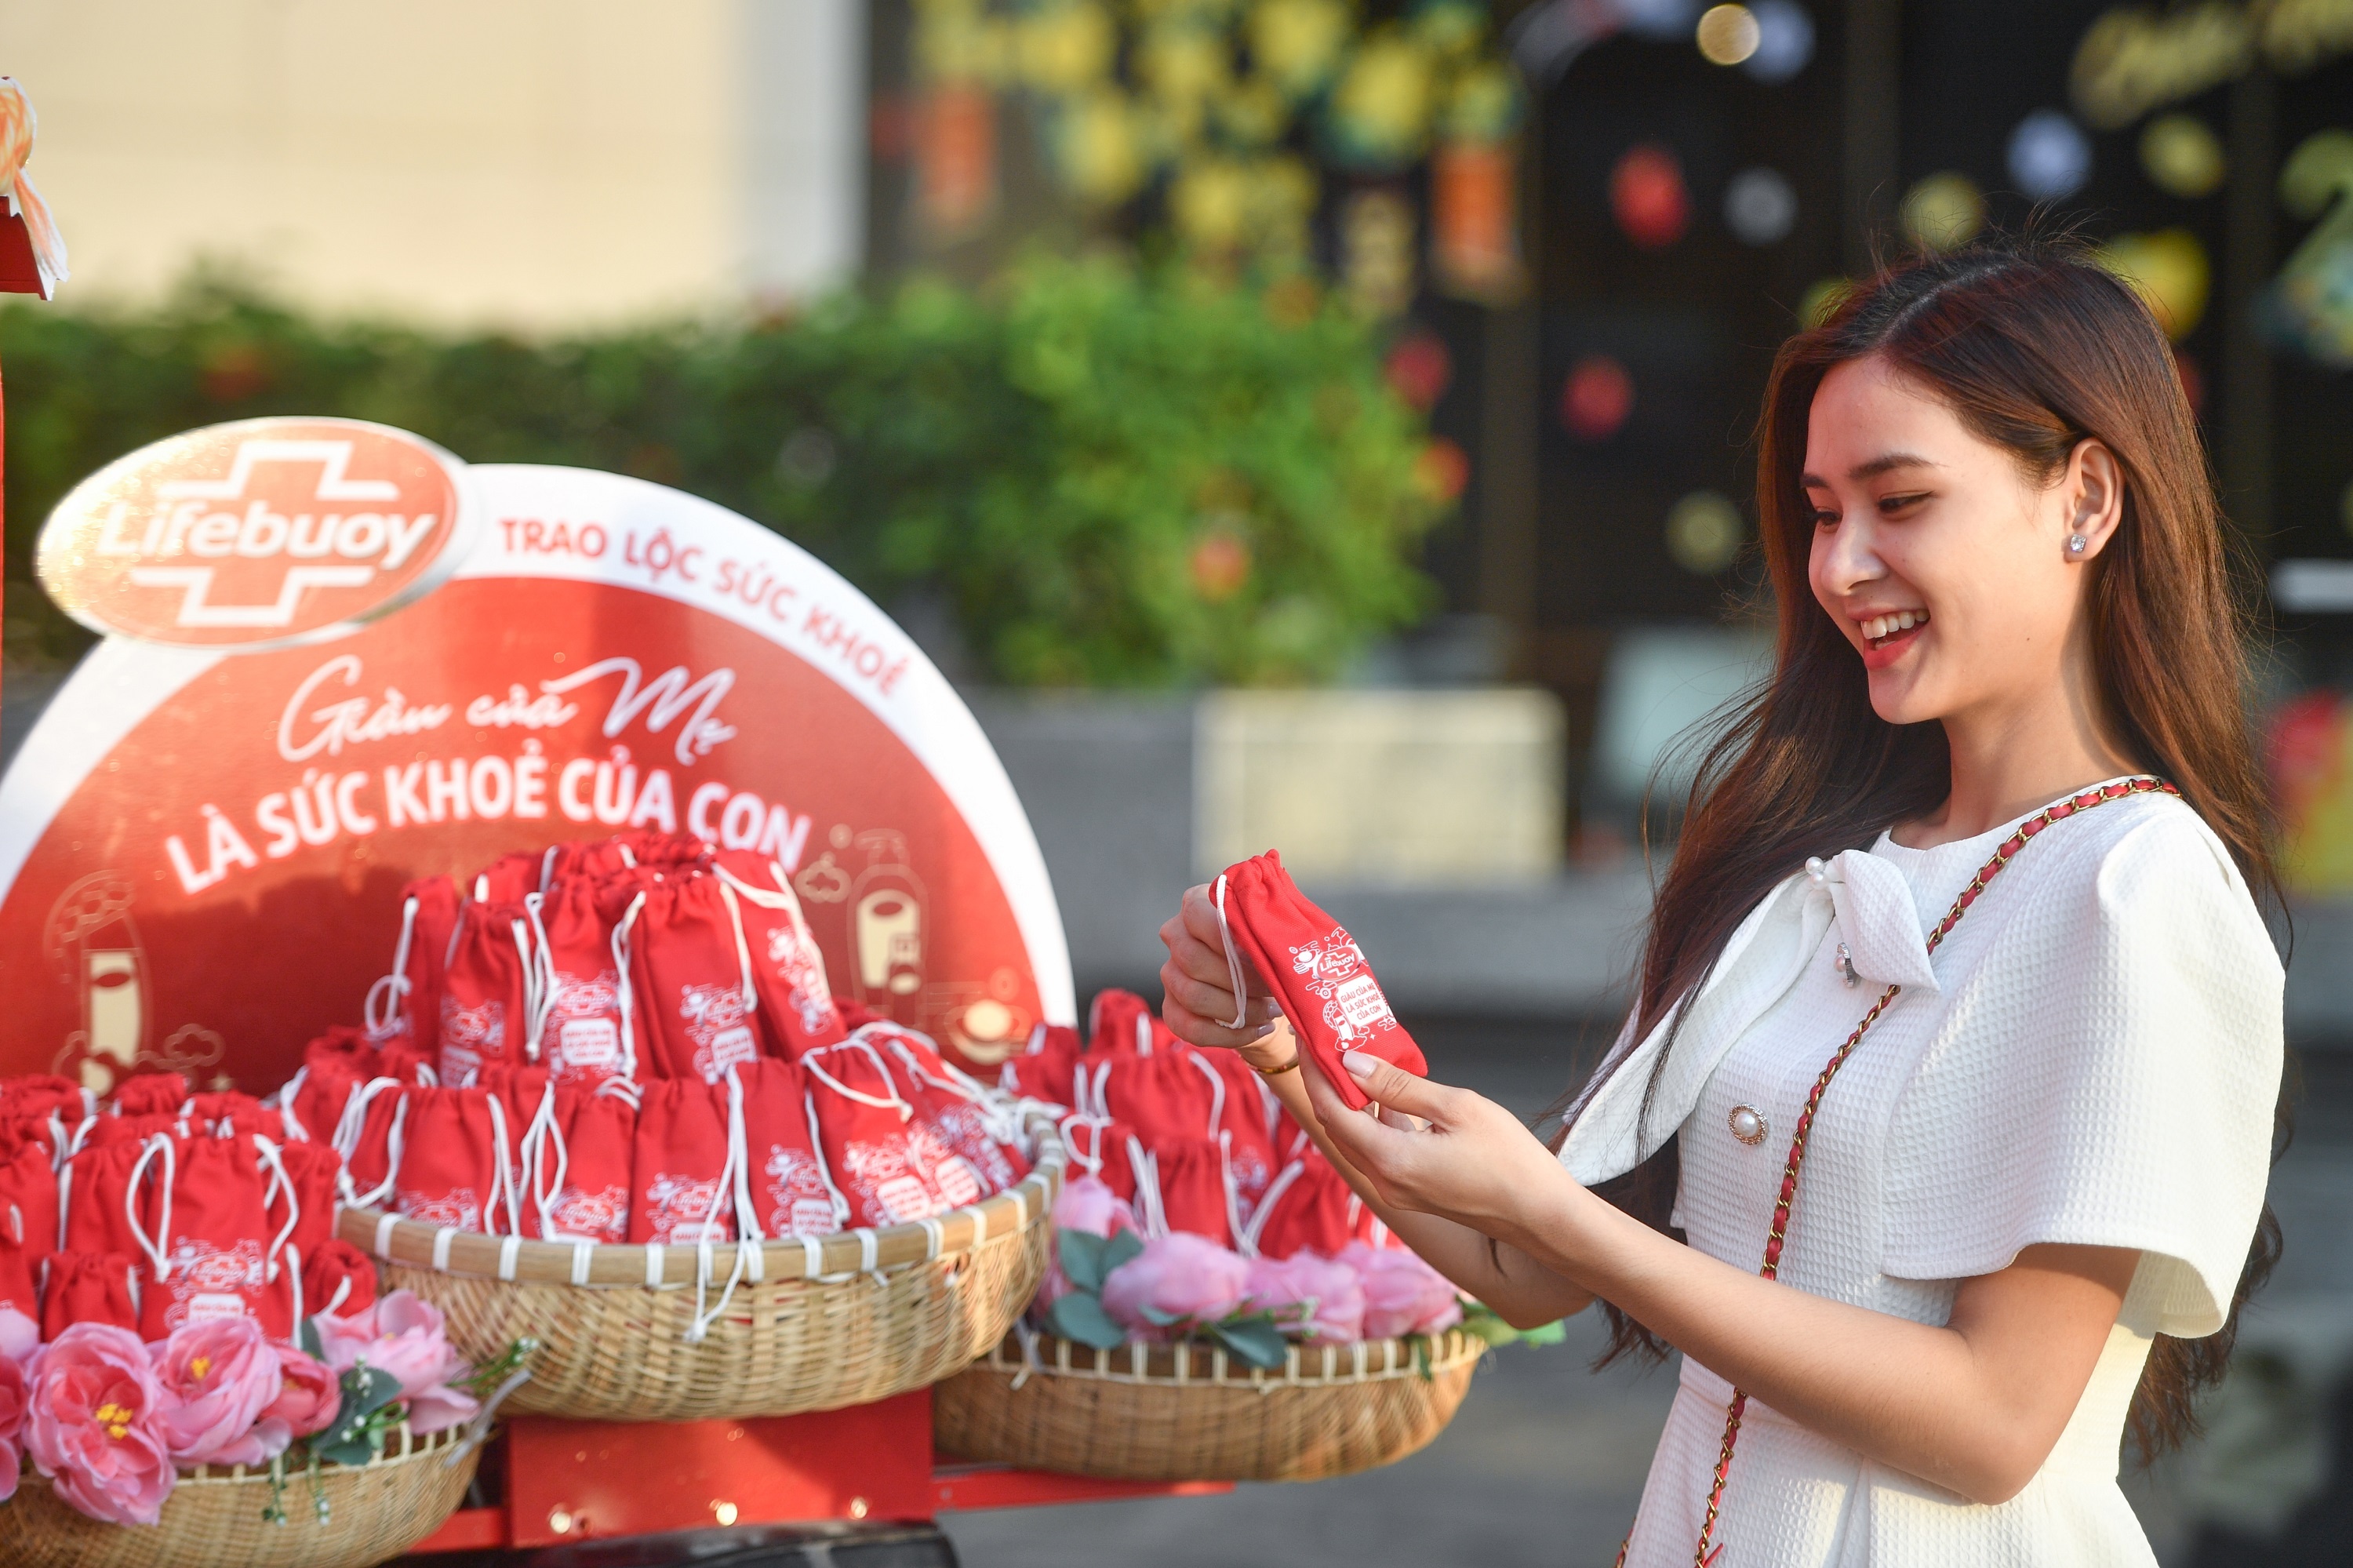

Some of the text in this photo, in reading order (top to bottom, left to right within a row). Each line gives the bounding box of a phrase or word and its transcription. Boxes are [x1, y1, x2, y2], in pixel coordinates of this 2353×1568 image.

[95, 500, 438, 569] Lifebuoy
[499, 518, 608, 559] TRAO
[621, 529, 703, 583] LỘC
[713, 559, 798, 623] SỨC
[165, 737, 811, 896] LÀ SỨC KHOẺ CỦA CON
[1319, 953, 1355, 973] Lifebuoy
[1340, 991, 1356, 1003] GIÀU
[1355, 985, 1369, 996] CỦA
[1345, 1002, 1356, 1013] LÀ
[1355, 999, 1367, 1010] SỨC
[1356, 1004, 1382, 1020] CỦA CON
